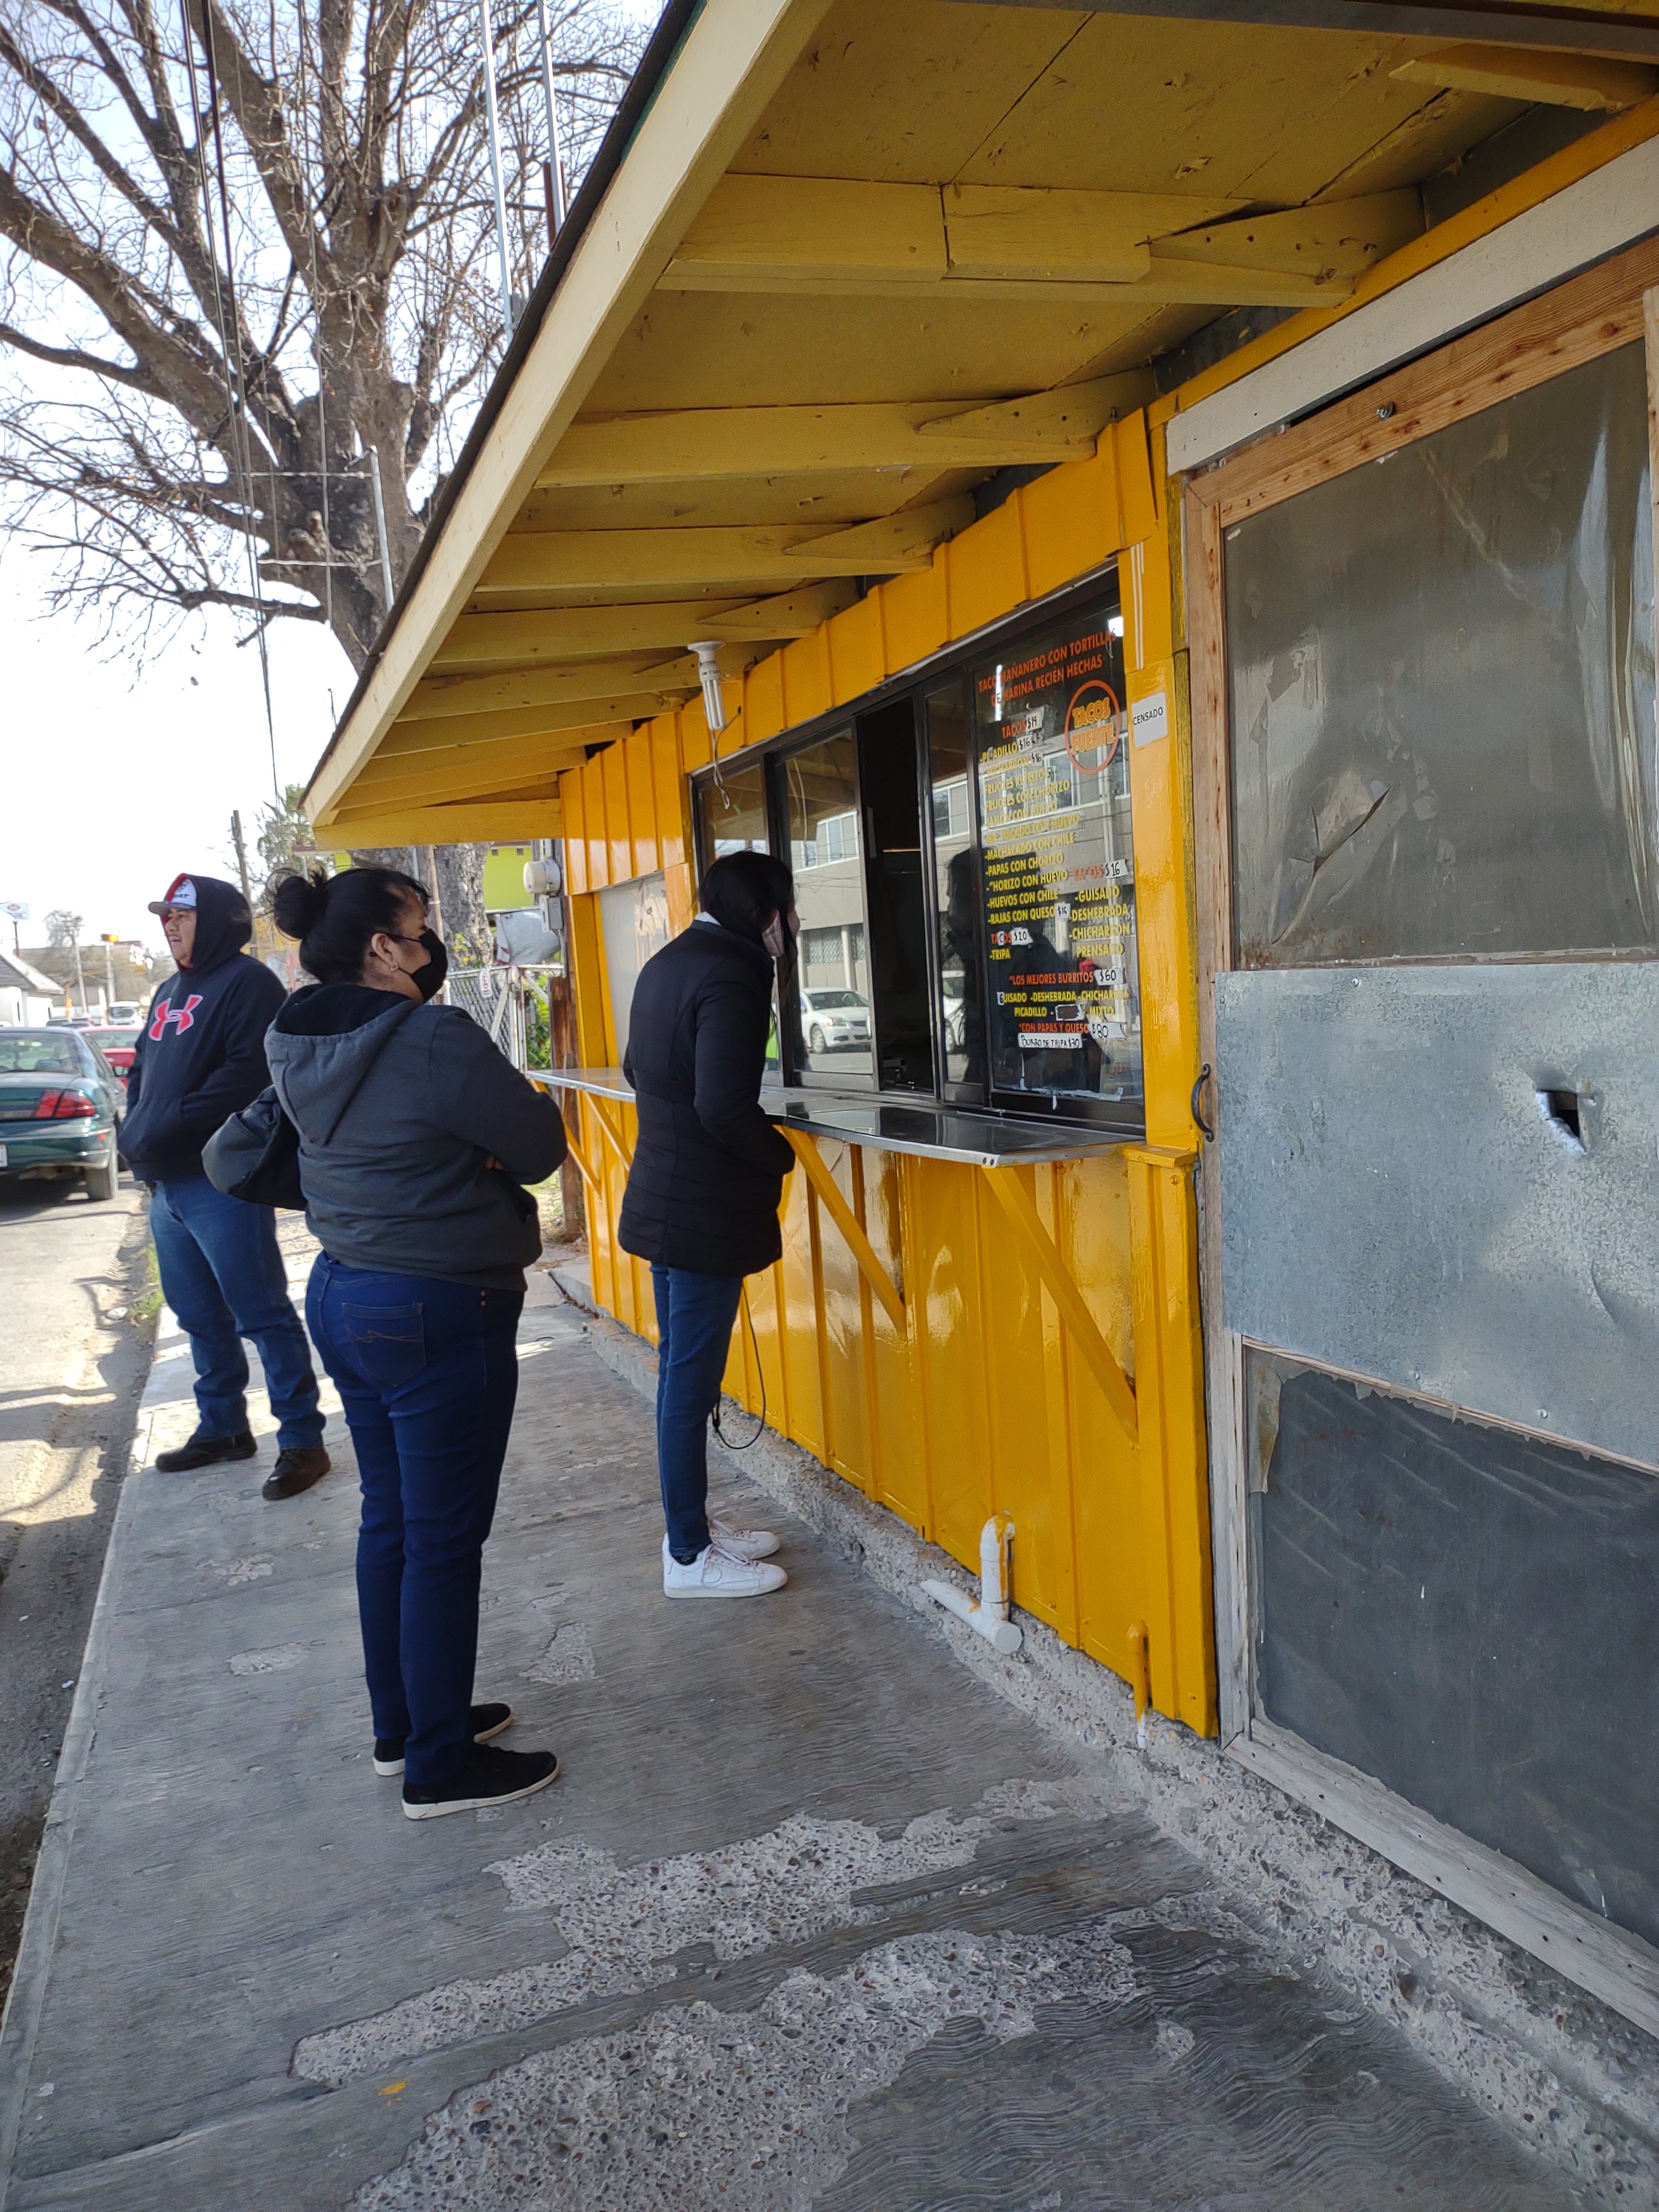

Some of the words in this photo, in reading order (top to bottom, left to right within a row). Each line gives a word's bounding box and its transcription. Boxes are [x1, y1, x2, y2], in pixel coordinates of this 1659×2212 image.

[1001, 654, 1046, 683] MAÑANERO
[1048, 646, 1068, 664] CON
[1070, 628, 1117, 656] TORTILLAS
[1003, 680, 1034, 702] HARINA
[1035, 667, 1065, 690] RECIÉN
[1067, 654, 1103, 679] HECHAS
[1072, 697, 1111, 729] TACOS
[1133, 707, 1164, 726] CENSADO
[1019, 738, 1030, 750] $16
[1071, 722, 1114, 755] FUENTE
[1016, 789, 1033, 804] CON
[1033, 837, 1051, 852] CON
[1052, 831, 1075, 846] CHILE
[1010, 859, 1027, 873] CON
[1028, 852, 1064, 870] CHORIZO
[1105, 862, 1120, 877] $16
[1022, 874, 1039, 888] CON
[1040, 869, 1068, 885] HUEVO
[1019, 891, 1035, 904] CON
[1037, 888, 1059, 902] CHILE
[1012, 907, 1029, 920] CON
[1030, 905, 1055, 921] QUESO
[1014, 931, 1027, 941] $20
[1076, 942, 1125, 958] PRENSADO
[1026, 973, 1056, 985] MEJORES
[1058, 971, 1094, 984] BURRITOS
[1099, 969, 1117, 982] $60
[1014, 1006, 1047, 1017] PICADILLO
[1089, 1005, 1114, 1016] MIXTO
[1037, 1022, 1057, 1032] PAPAS
[1058, 1023, 1063, 1032] Y
[1065, 1023, 1089, 1034] QUESO
[1092, 1024, 1109, 1038] $80
[1021, 1035, 1042, 1047] BURRO
[1051, 1039, 1067, 1048] TRIPA
